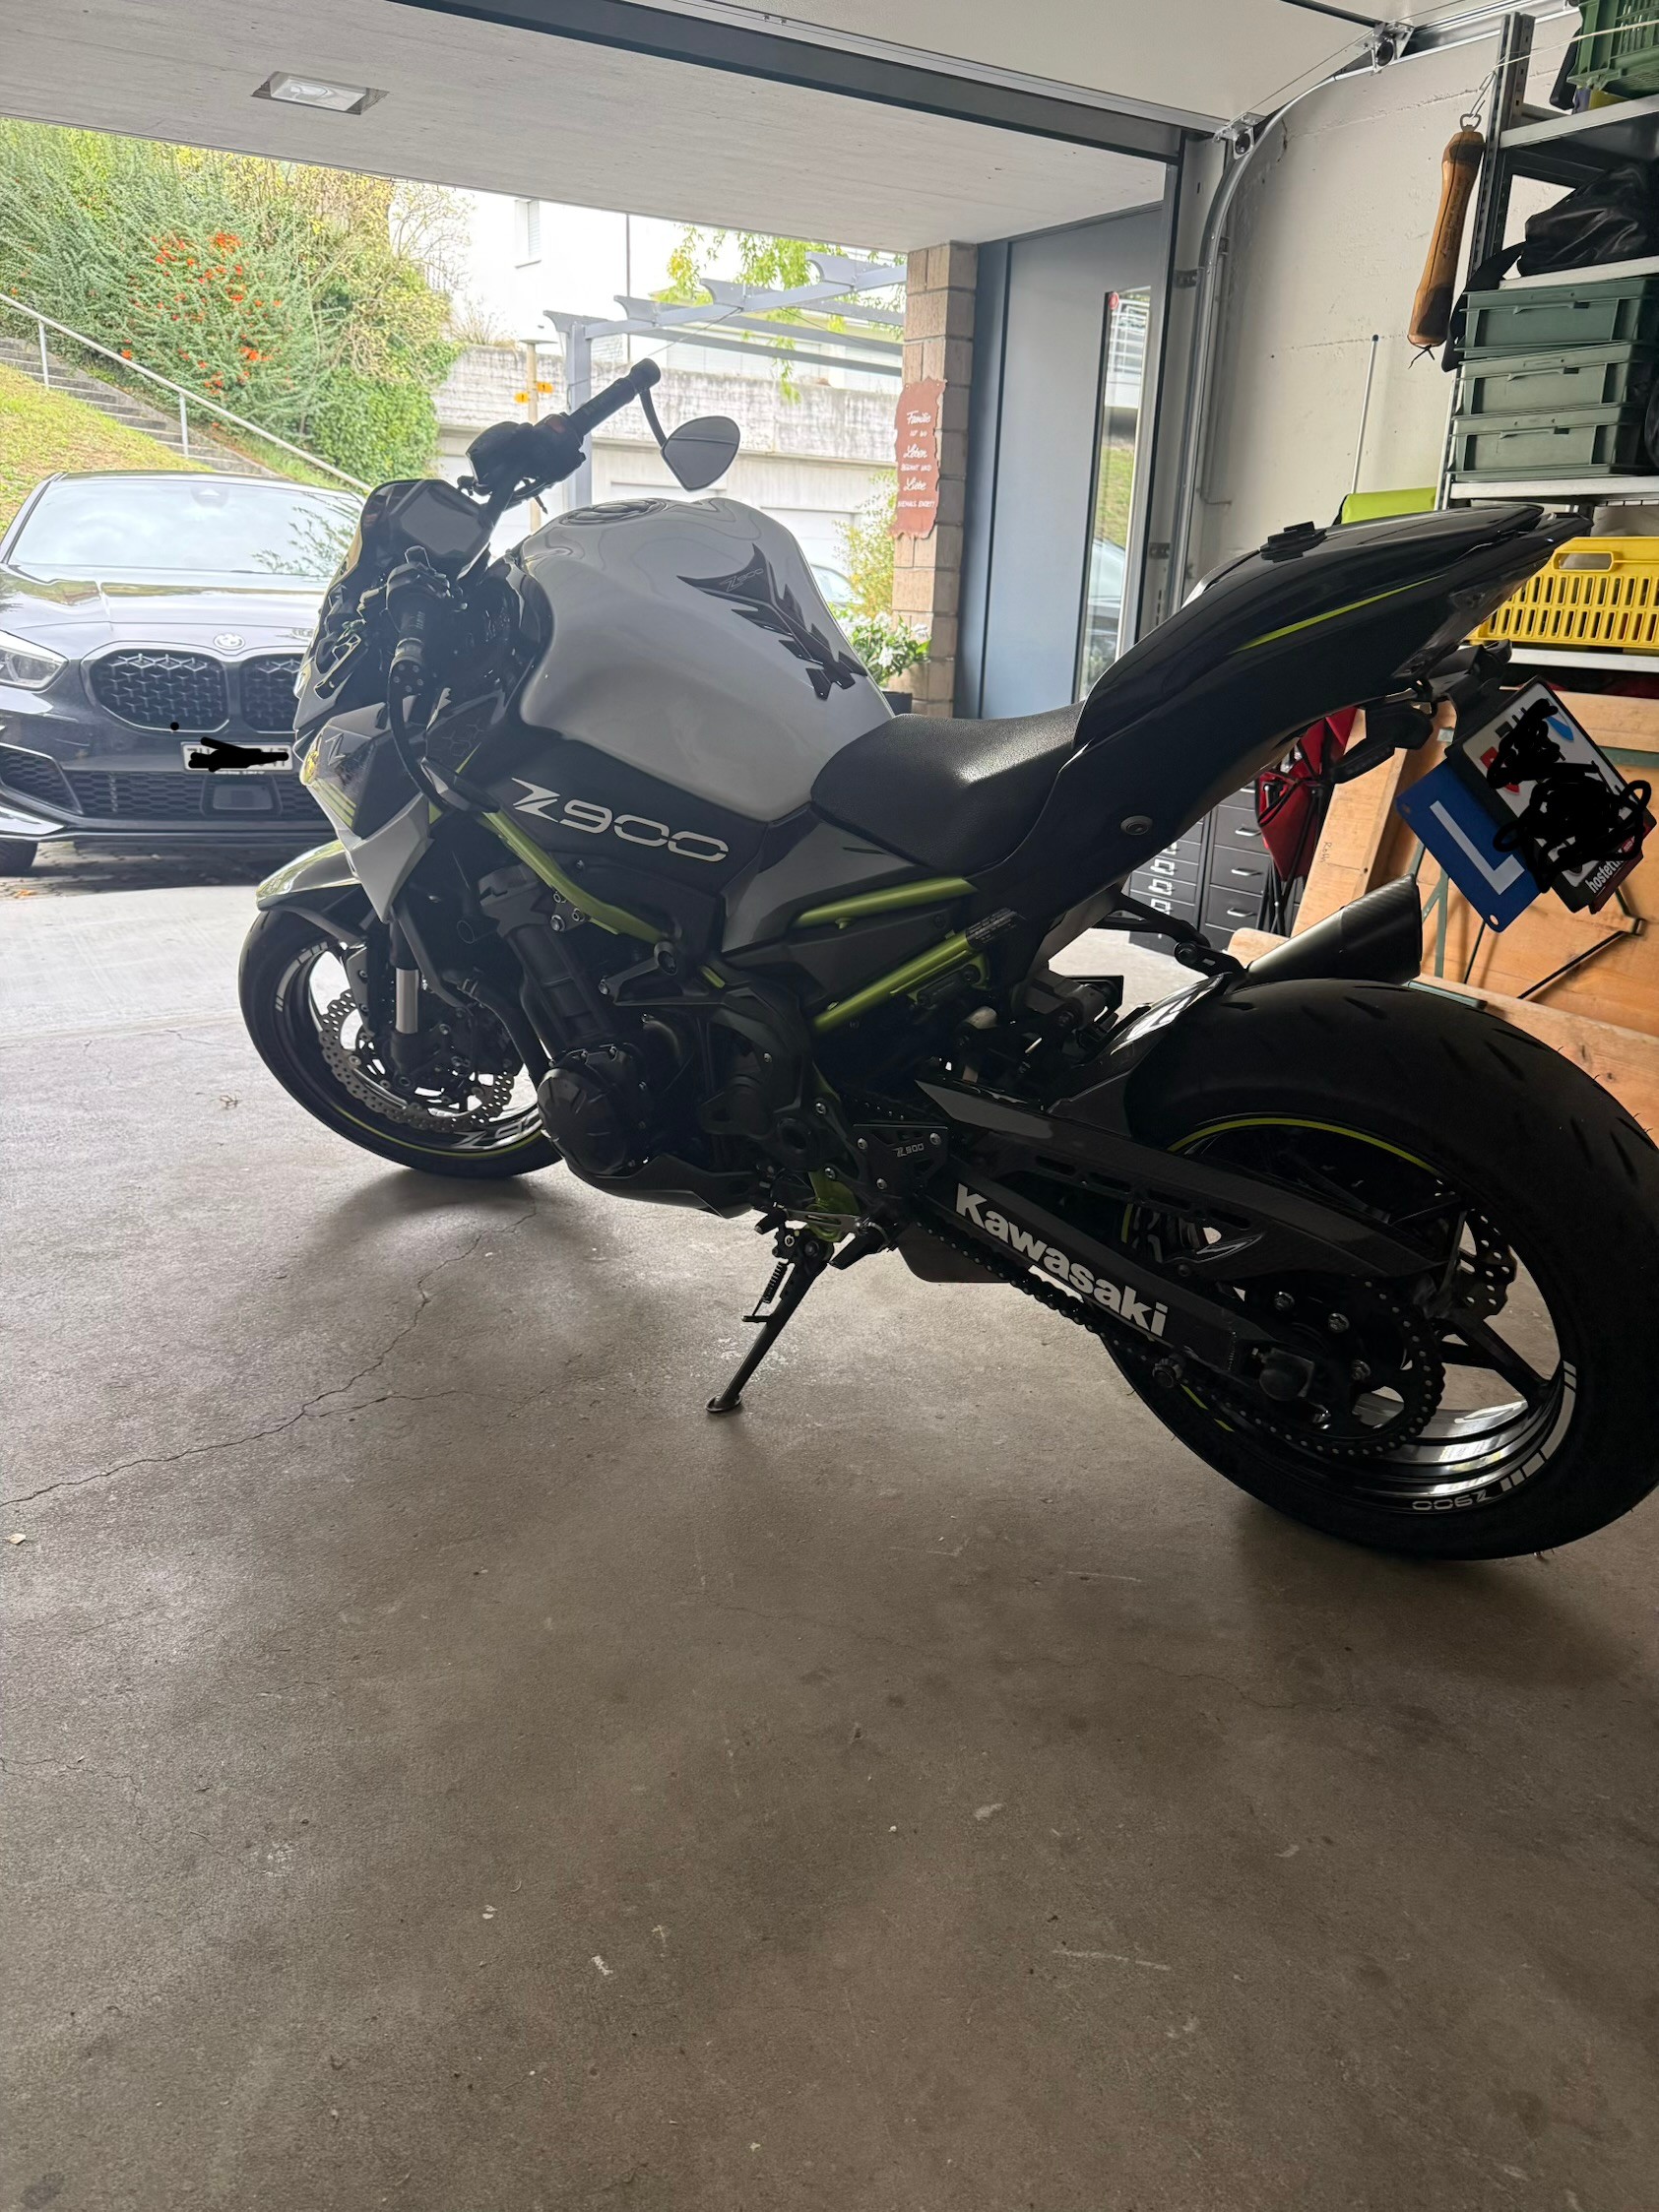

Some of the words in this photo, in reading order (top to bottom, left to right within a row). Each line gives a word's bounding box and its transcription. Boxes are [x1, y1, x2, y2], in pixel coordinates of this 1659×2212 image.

[720, 567, 764, 593] Z900
[510, 777, 731, 863] Z900
[1429, 799, 1525, 896] L
[955, 1182, 1169, 1338] Kawasaki
[1412, 1488, 1494, 1511] Z900
